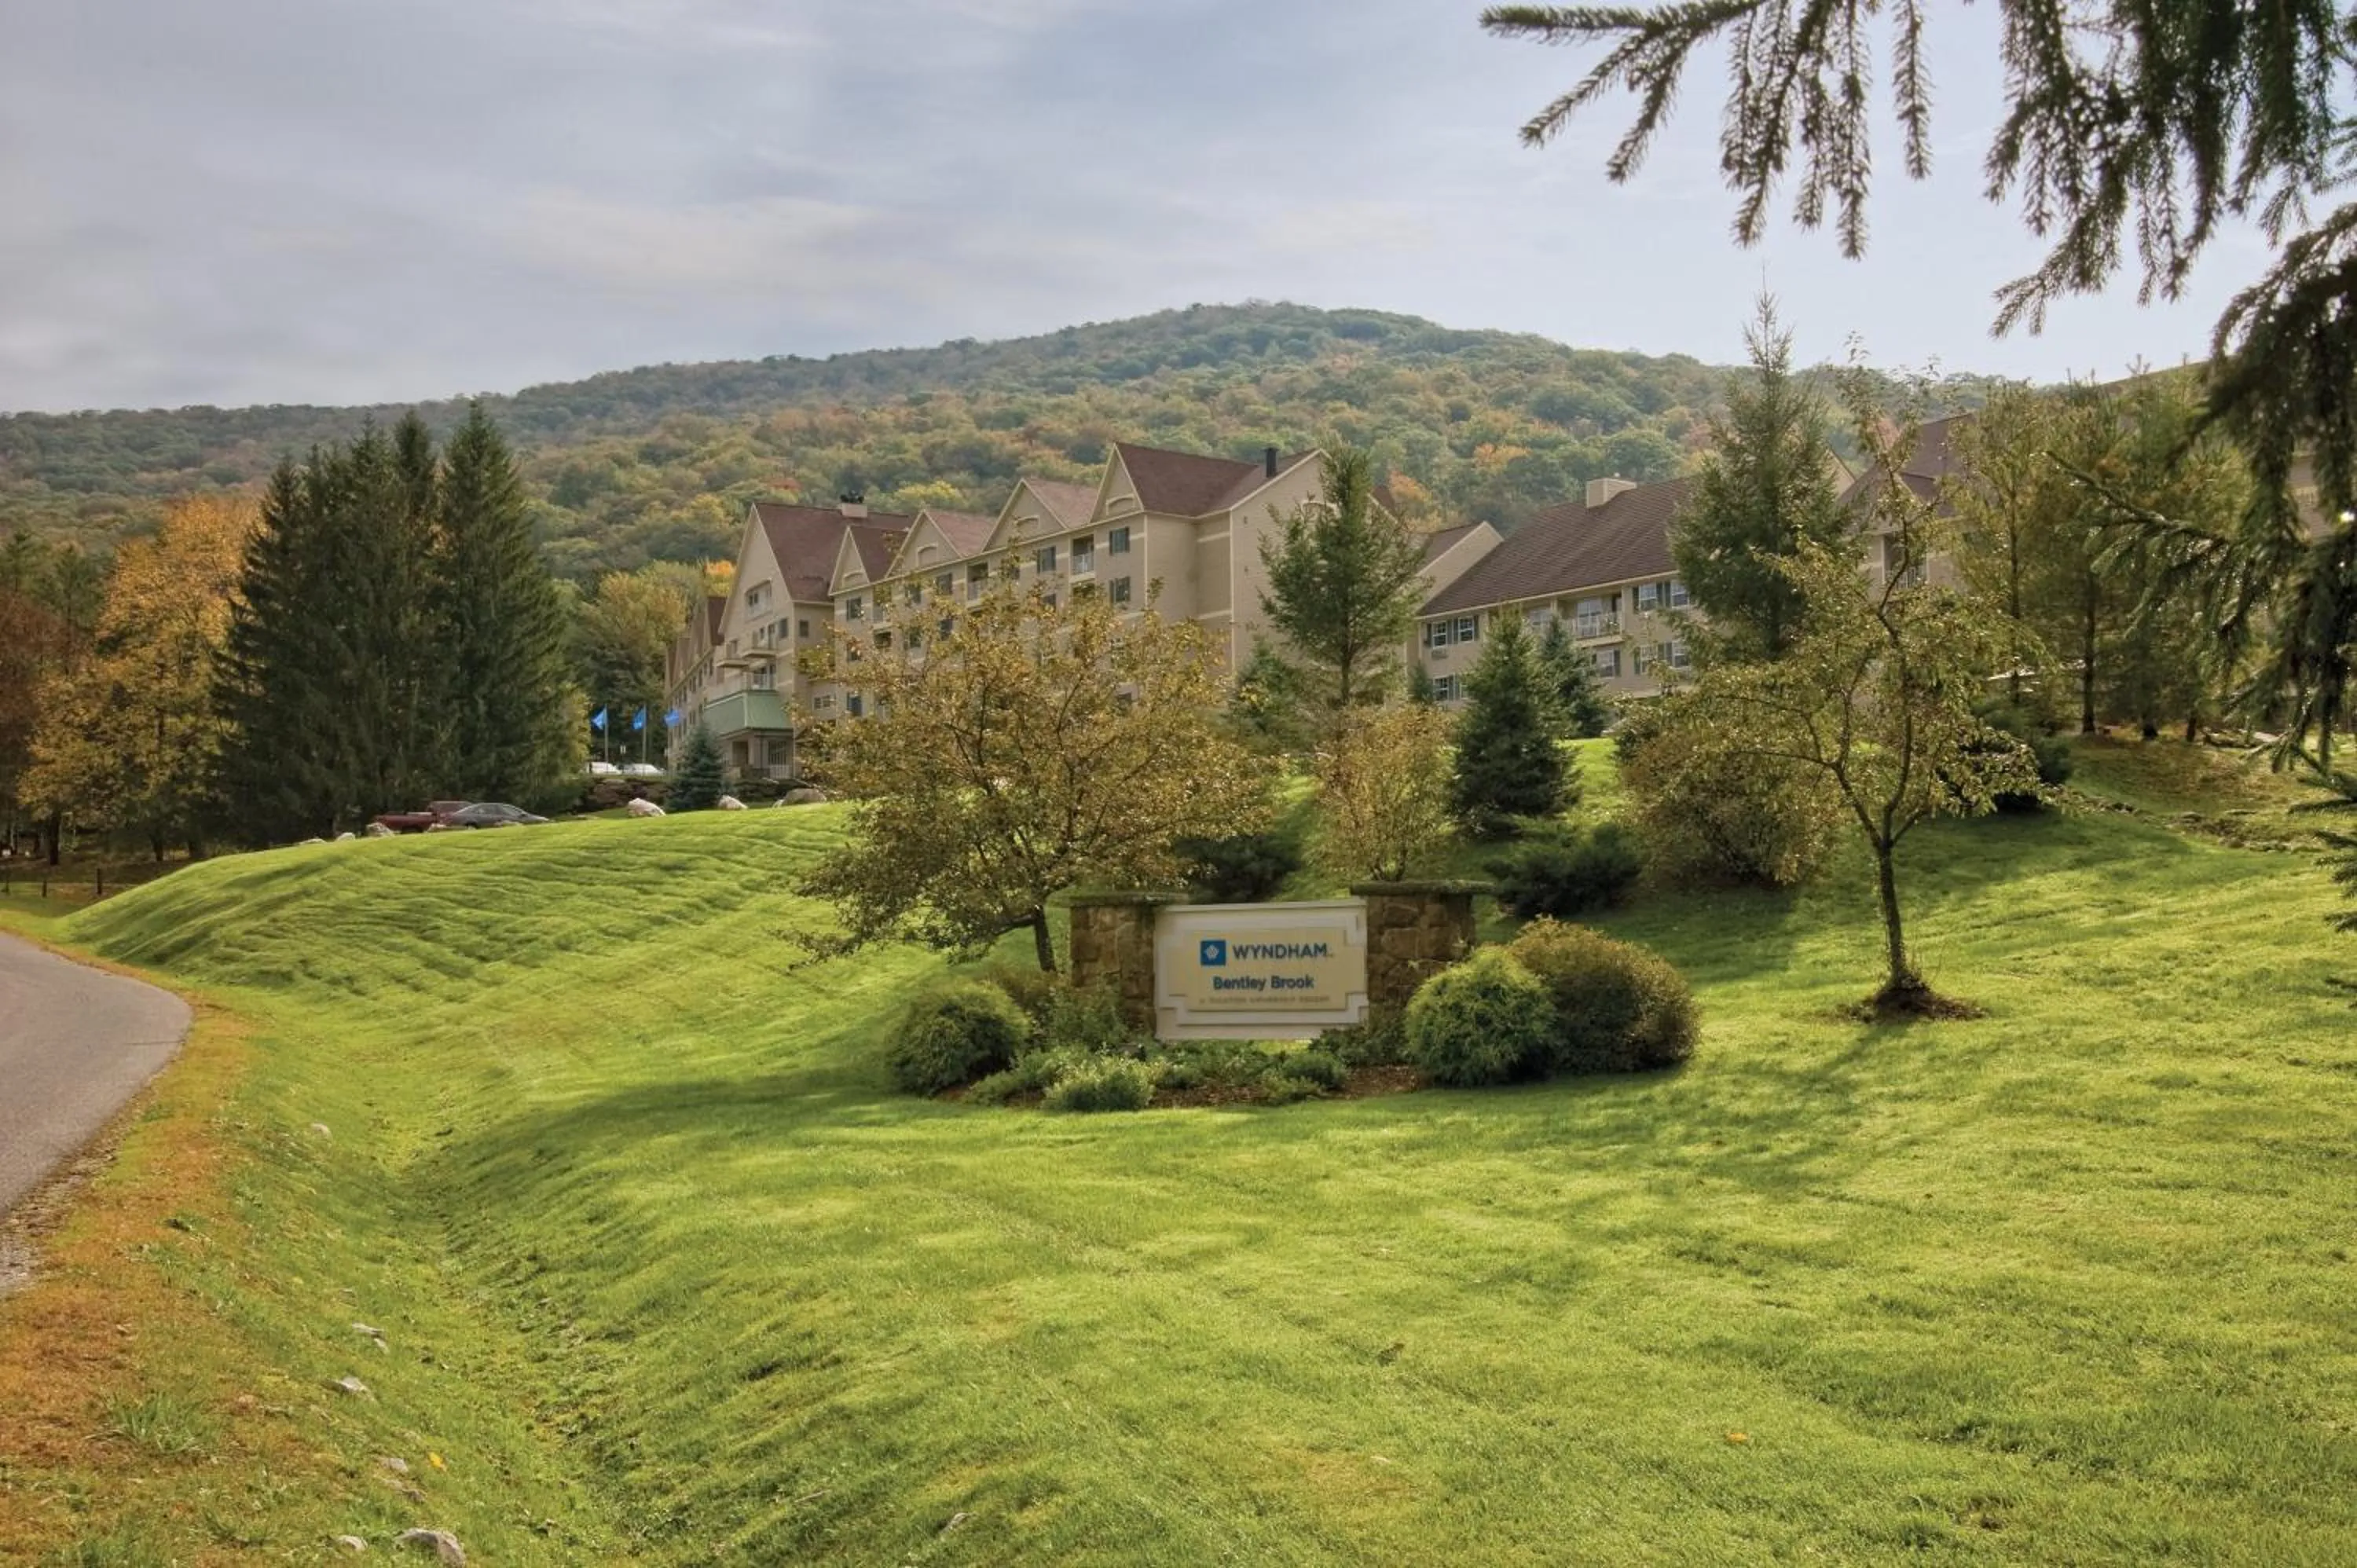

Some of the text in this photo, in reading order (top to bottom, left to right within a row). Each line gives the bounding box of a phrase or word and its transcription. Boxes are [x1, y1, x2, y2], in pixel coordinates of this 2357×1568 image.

[1232, 943, 1328, 959] WYNDHAM
[1212, 975, 1314, 991] Bentley Brook
